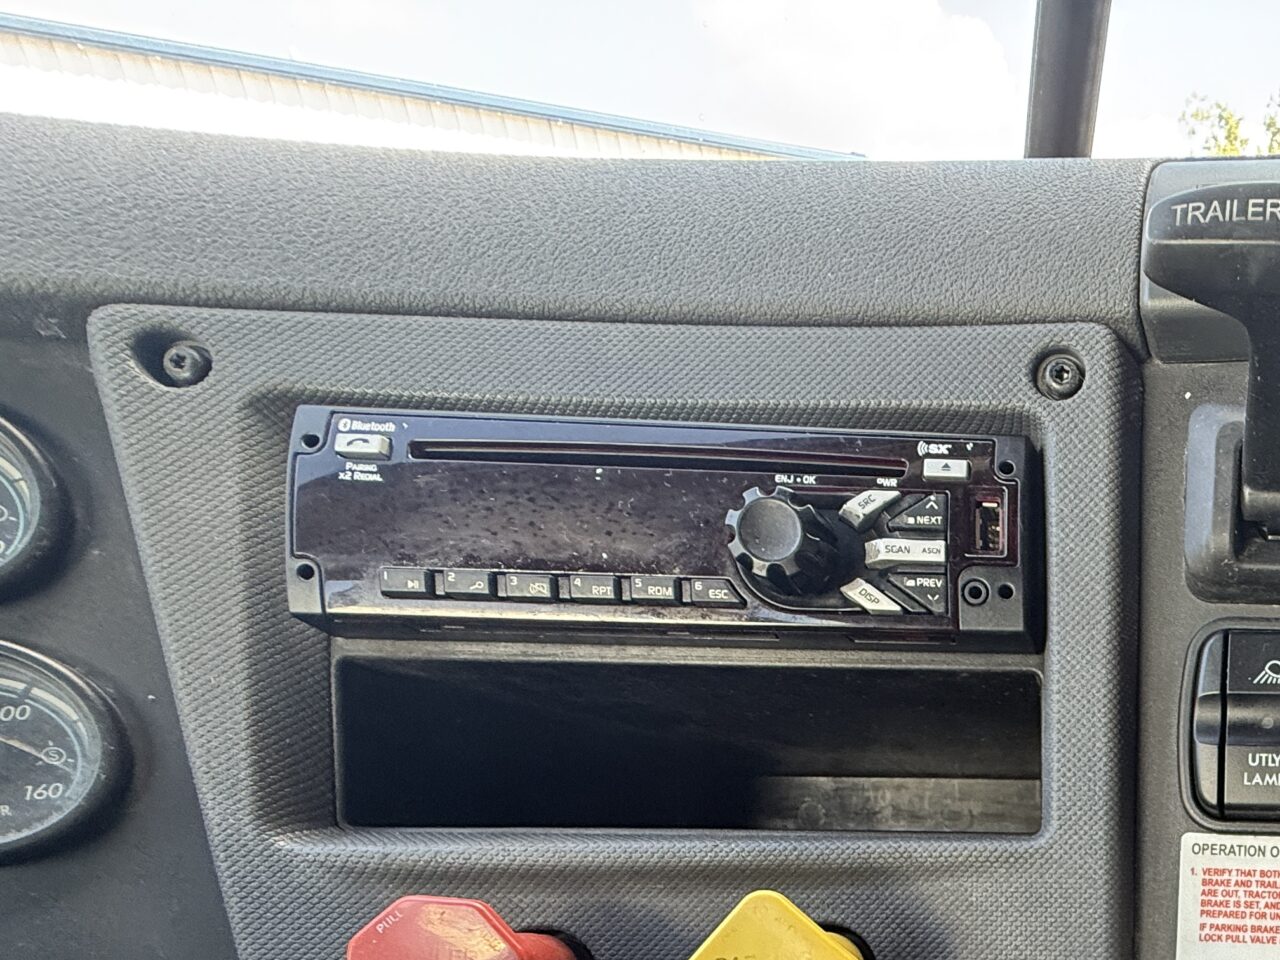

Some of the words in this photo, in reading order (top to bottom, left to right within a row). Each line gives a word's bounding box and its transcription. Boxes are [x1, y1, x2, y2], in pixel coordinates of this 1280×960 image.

[351, 420, 396, 432] Bluetooth
[803, 475, 817, 484] OK
[858, 494, 877, 510] SRC
[916, 516, 943, 525] NEXT
[884, 545, 911, 554] SCAN
[447, 572, 456, 581] 2
[510, 576, 518, 586] 3
[574, 577, 581, 587] 4
[635, 578, 643, 588] 5
[694, 581, 702, 591] 6
[916, 578, 943, 588] PREV
[591, 586, 612, 596] RPT
[647, 586, 673, 596] RDM
[708, 589, 729, 599] ESC
[858, 588, 880, 605] DISP
[24, 783, 63, 801] 160
[1191, 843, 1266, 857] OPERATION
[1200, 910, 1247, 919] PREPARED
[1250, 911, 1267, 920] FOR
